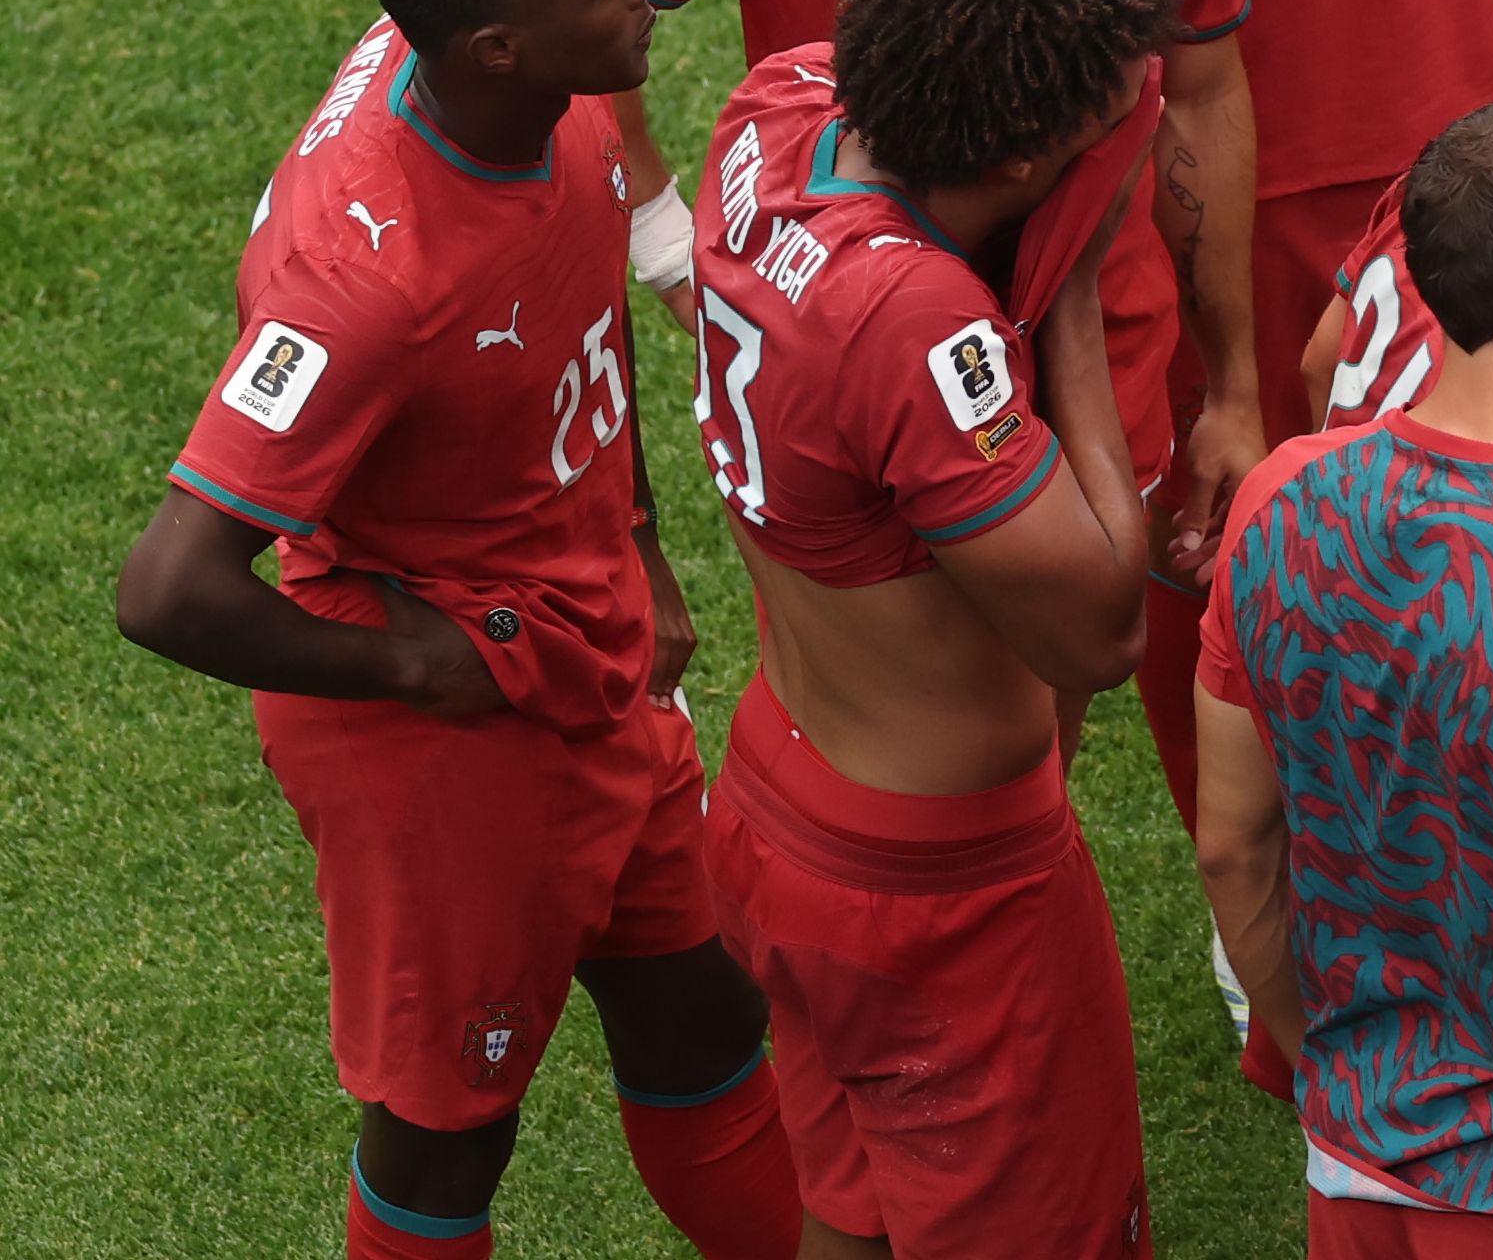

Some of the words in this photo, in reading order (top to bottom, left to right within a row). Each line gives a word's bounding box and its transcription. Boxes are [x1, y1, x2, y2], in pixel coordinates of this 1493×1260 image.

[238, 393, 272, 416] 2026
[552, 305, 627, 495] 25
[973, 392, 1002, 418] 2026
[989, 417, 1017, 442] DEBUT
